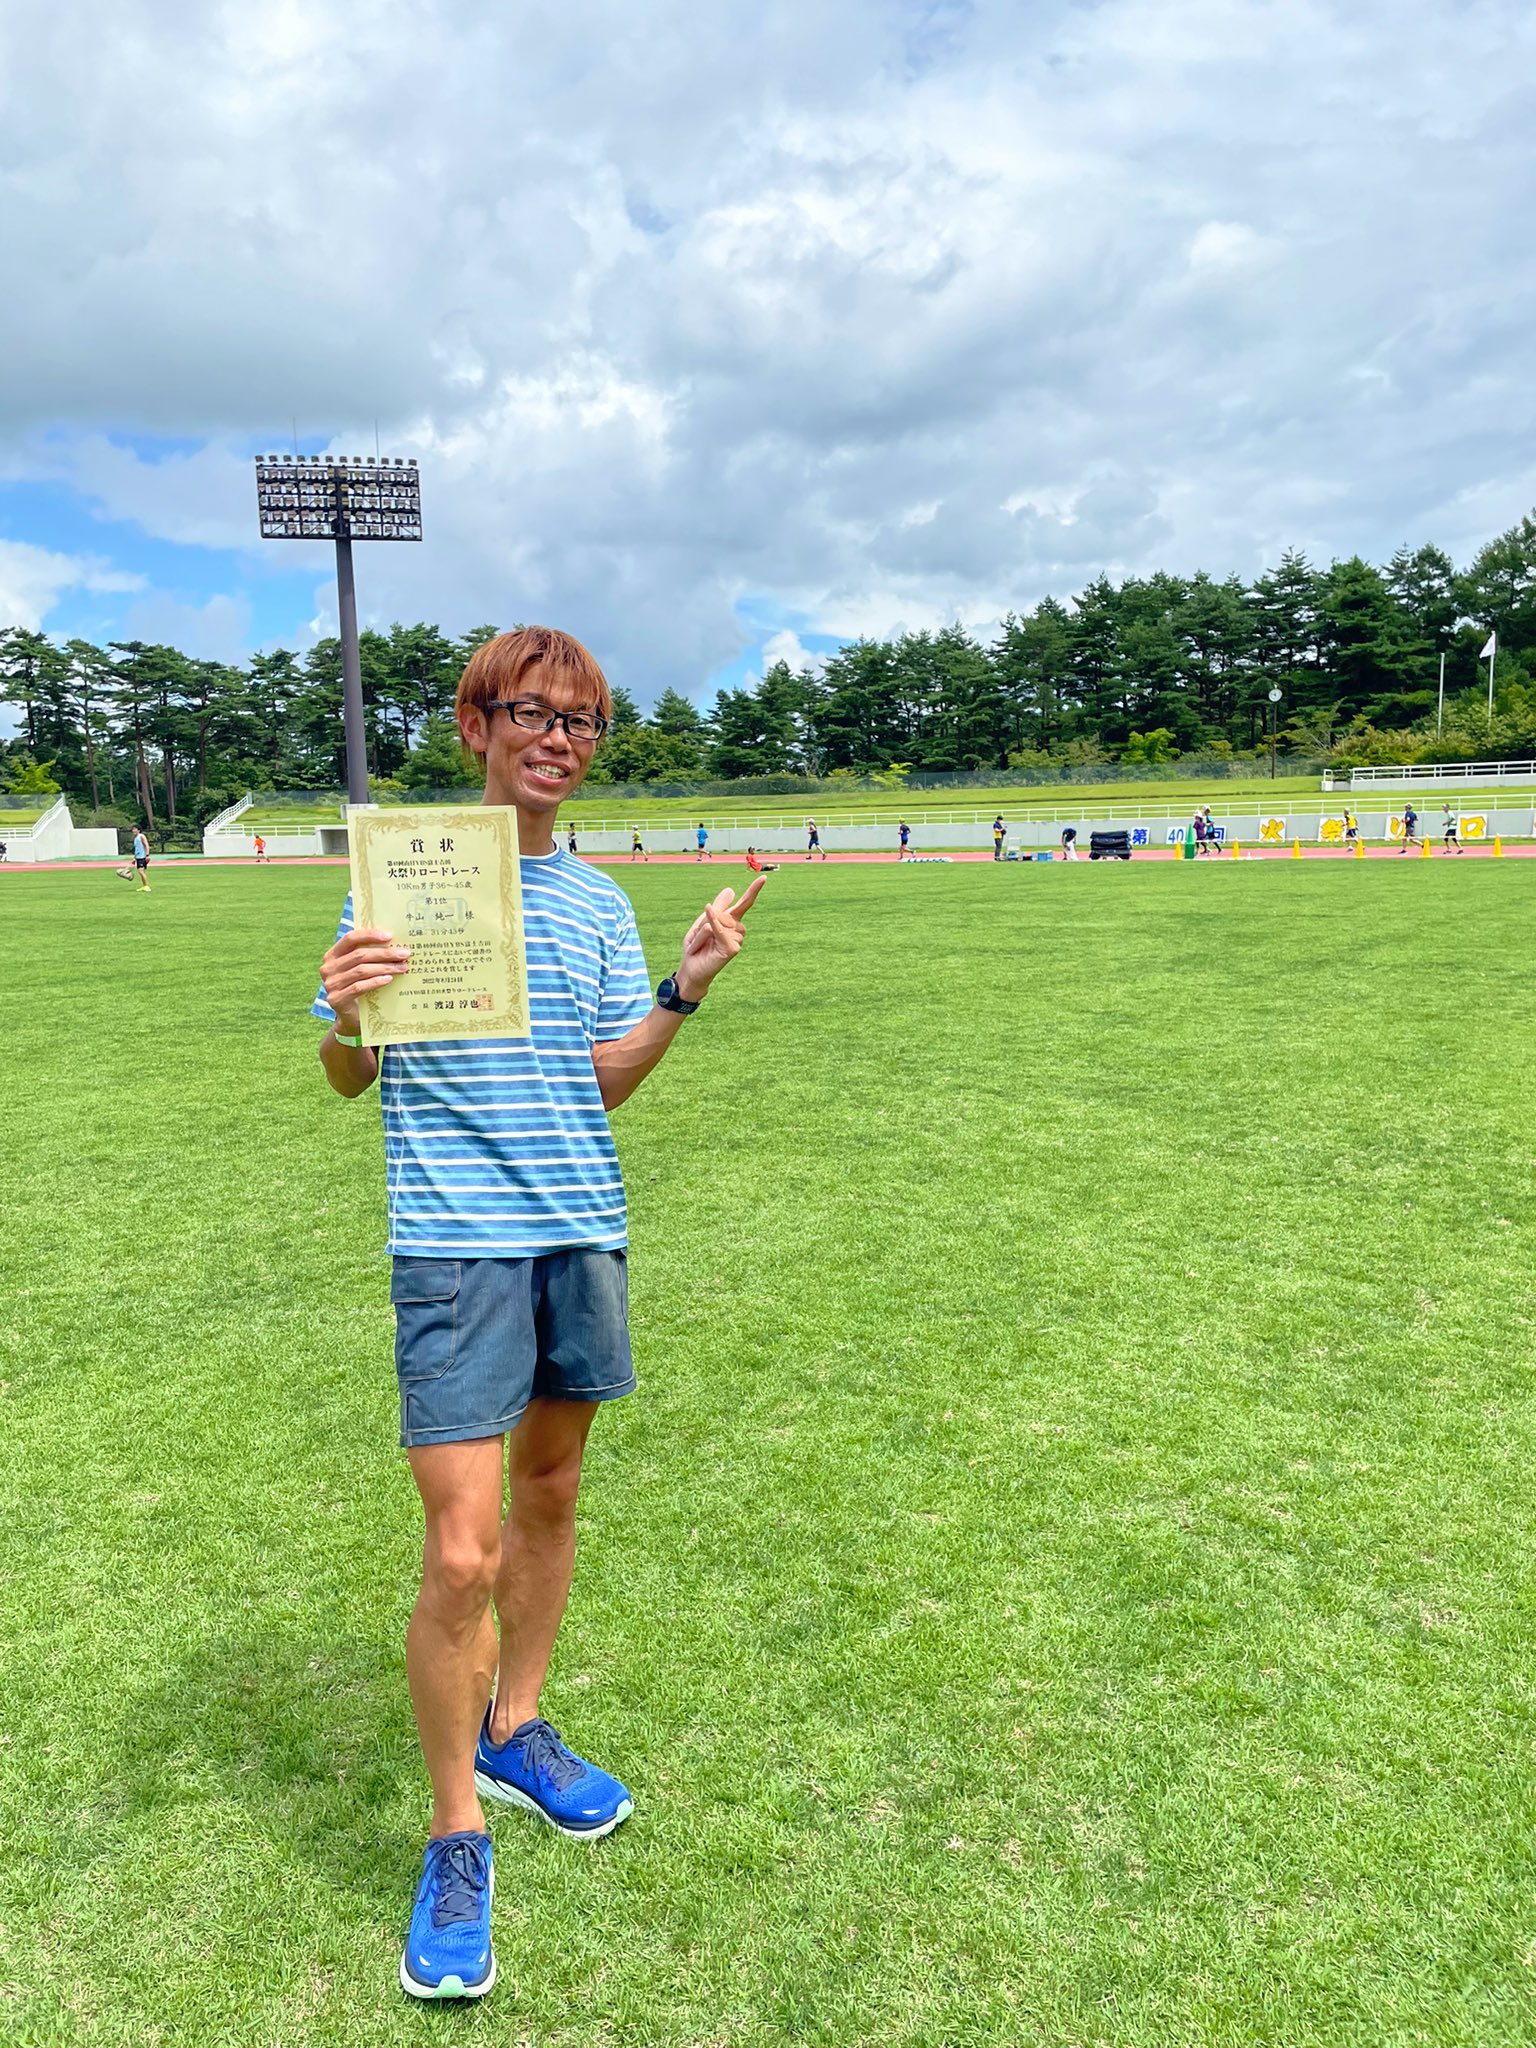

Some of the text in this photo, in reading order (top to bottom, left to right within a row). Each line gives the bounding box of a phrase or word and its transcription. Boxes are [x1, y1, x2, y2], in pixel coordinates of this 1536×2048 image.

[1168, 828, 1185, 843] 40
[387, 866, 481, 879] 火祭りロードレース
